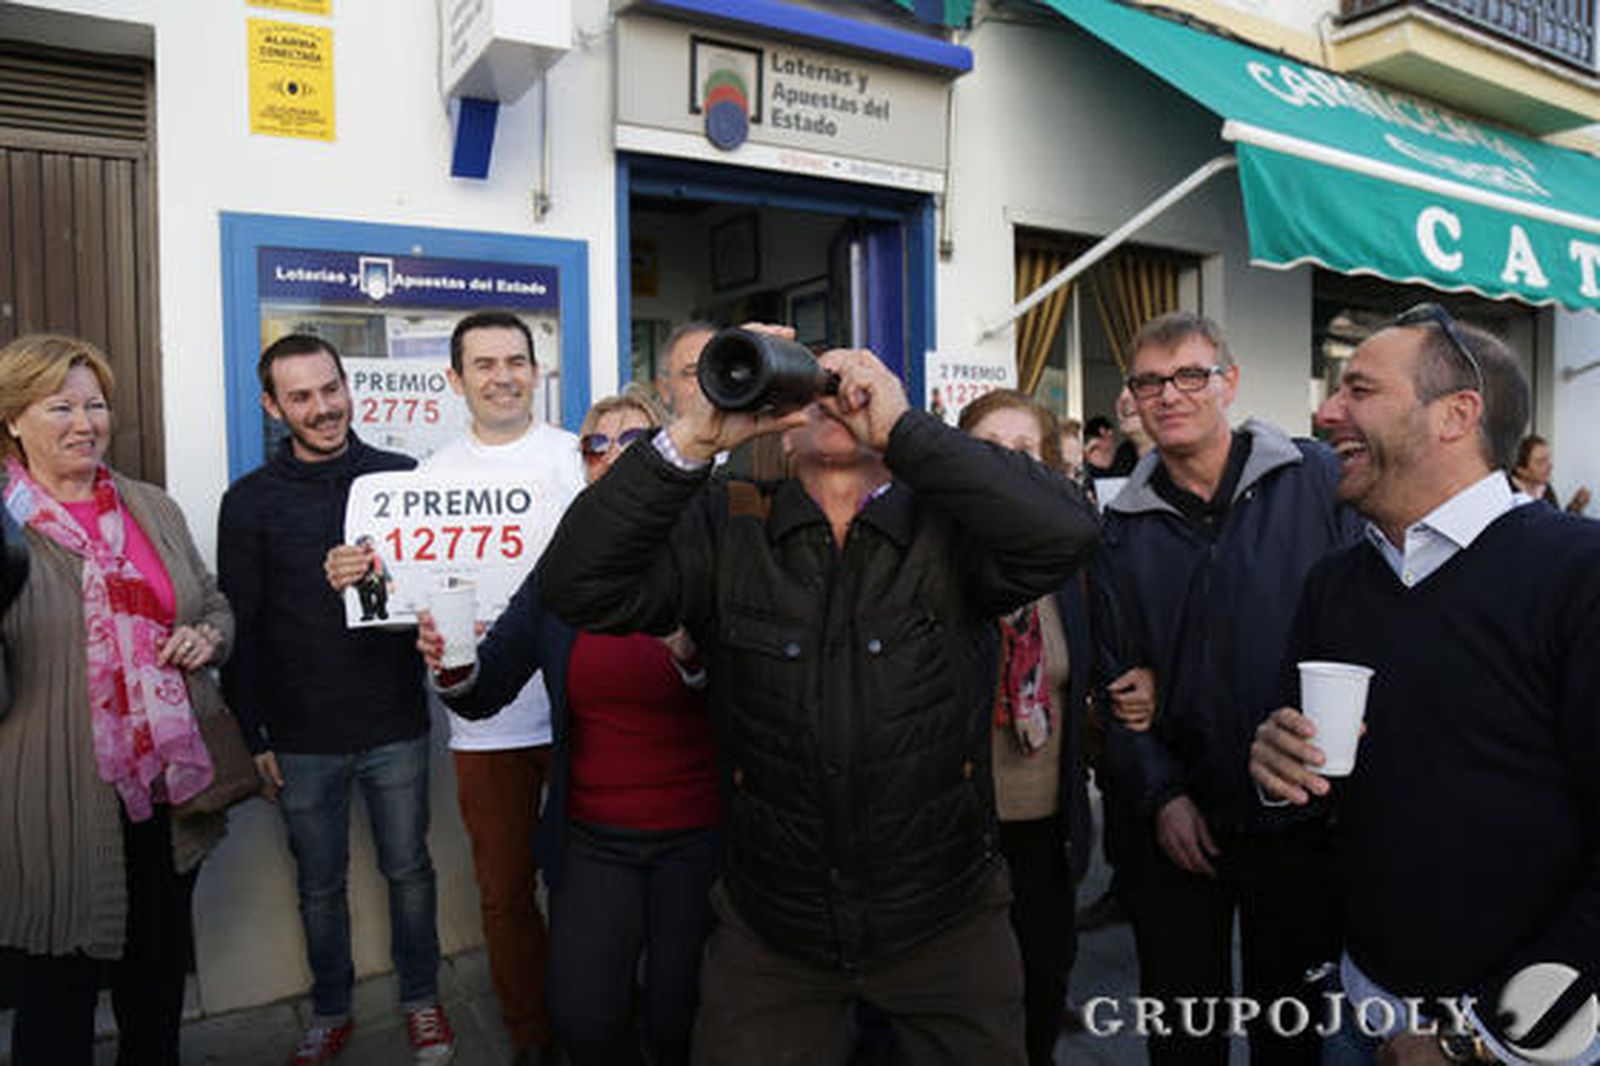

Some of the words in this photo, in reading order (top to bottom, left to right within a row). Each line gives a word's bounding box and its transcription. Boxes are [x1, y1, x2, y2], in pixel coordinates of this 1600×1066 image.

[856, 72, 869, 94] y
[771, 83, 859, 115] Apuestas
[863, 99, 890, 120] del
[771, 110, 838, 138] Estado
[349, 273, 360, 287] y
[394, 273, 466, 291] Apuestas
[468, 275, 493, 291] del
[496, 279, 548, 296] Estado
[354, 372, 446, 393] PREMIO
[952, 364, 1007, 381] PREMIO
[403, 488, 532, 517] PREMIO
[385, 525, 525, 561] 12775
